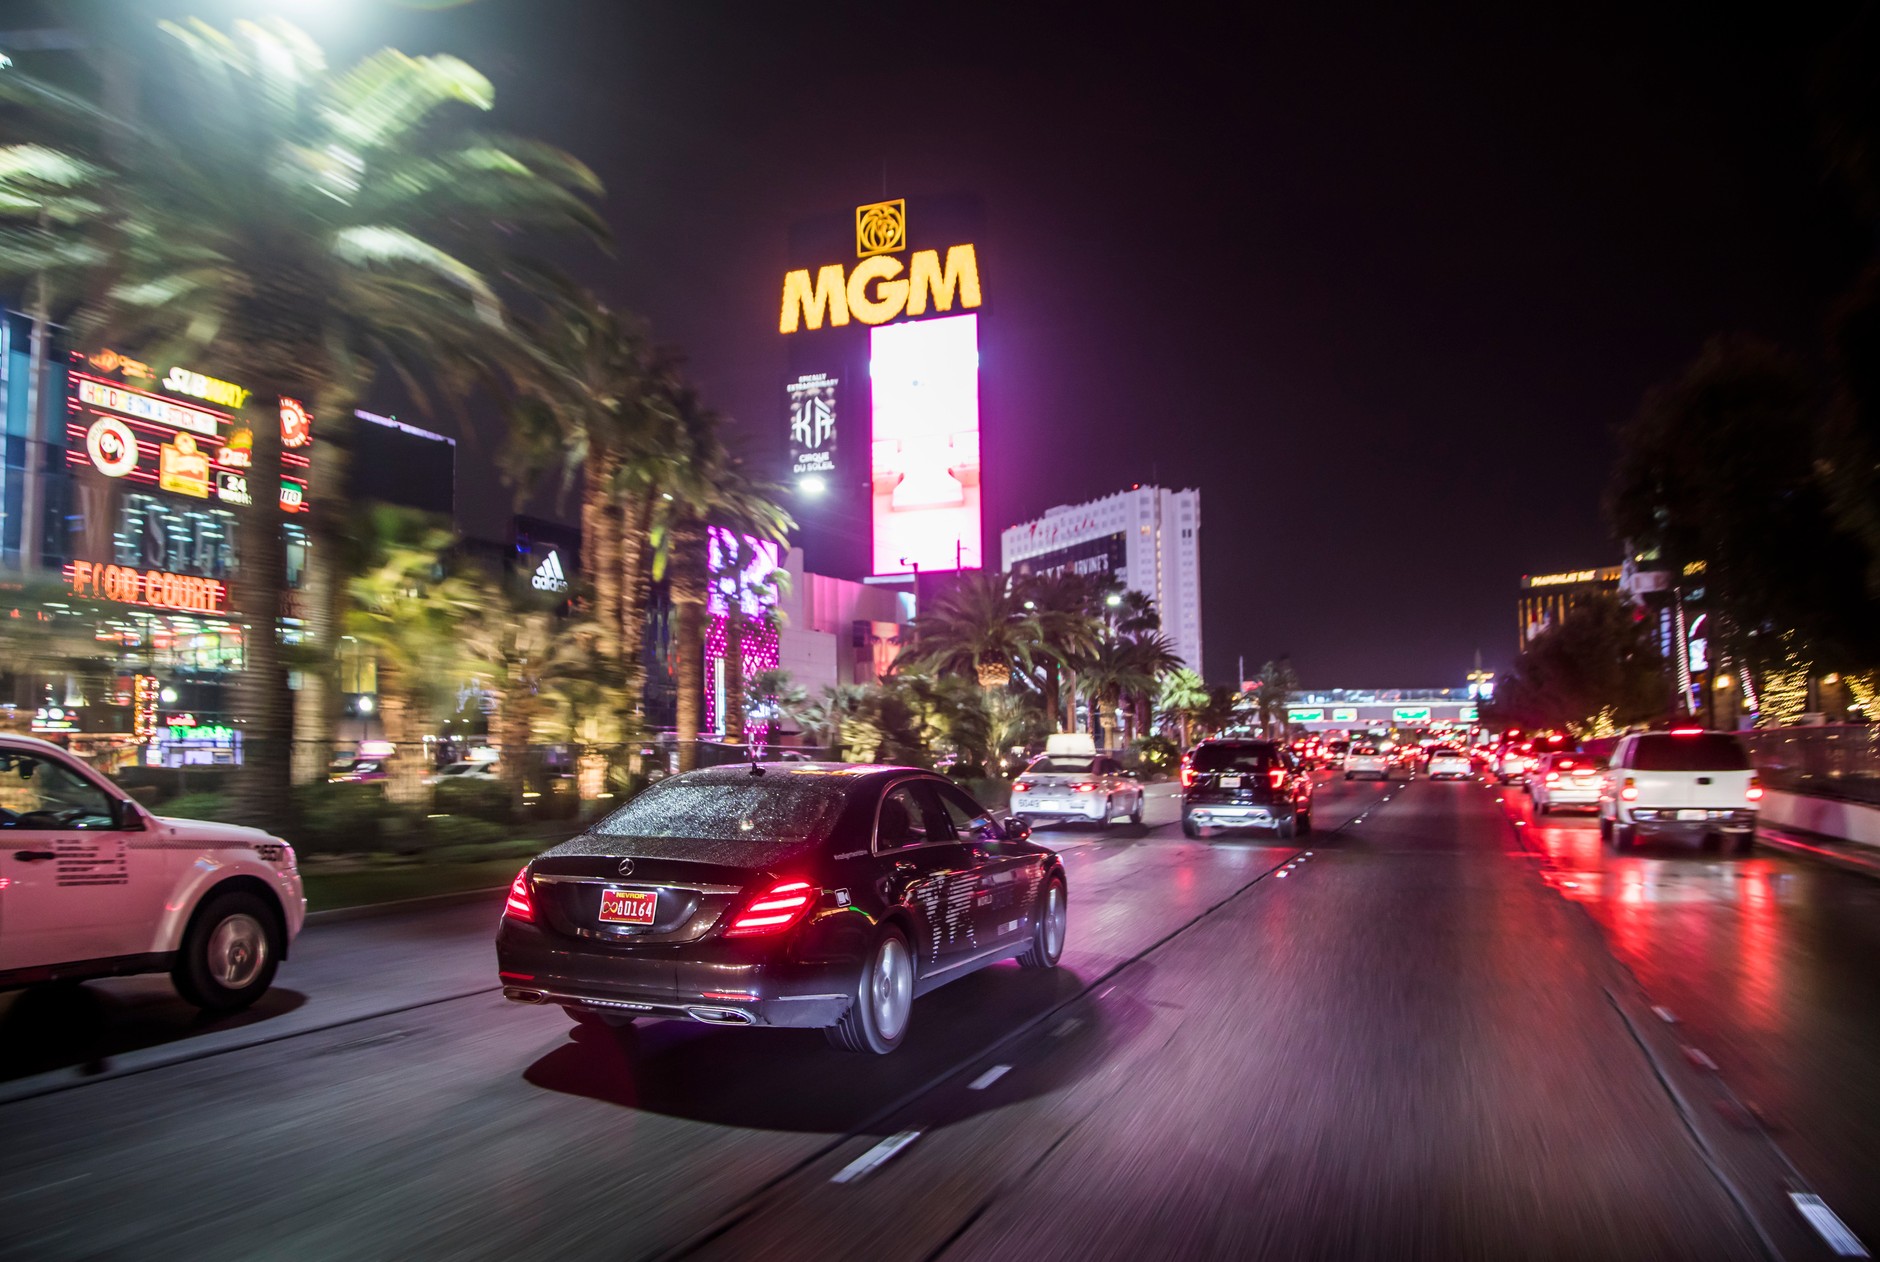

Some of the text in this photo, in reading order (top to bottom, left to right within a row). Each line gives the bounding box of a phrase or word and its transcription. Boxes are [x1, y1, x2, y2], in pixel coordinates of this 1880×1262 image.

[779, 243, 982, 334] MGM
[162, 366, 252, 408] SUBWAY
[799, 451, 829, 463] CIRQUE
[794, 461, 835, 473] DU SOLEIL
[227, 476, 247, 492] 24
[73, 560, 223, 612] FOOD COURT
[532, 574, 568, 593] adidas
